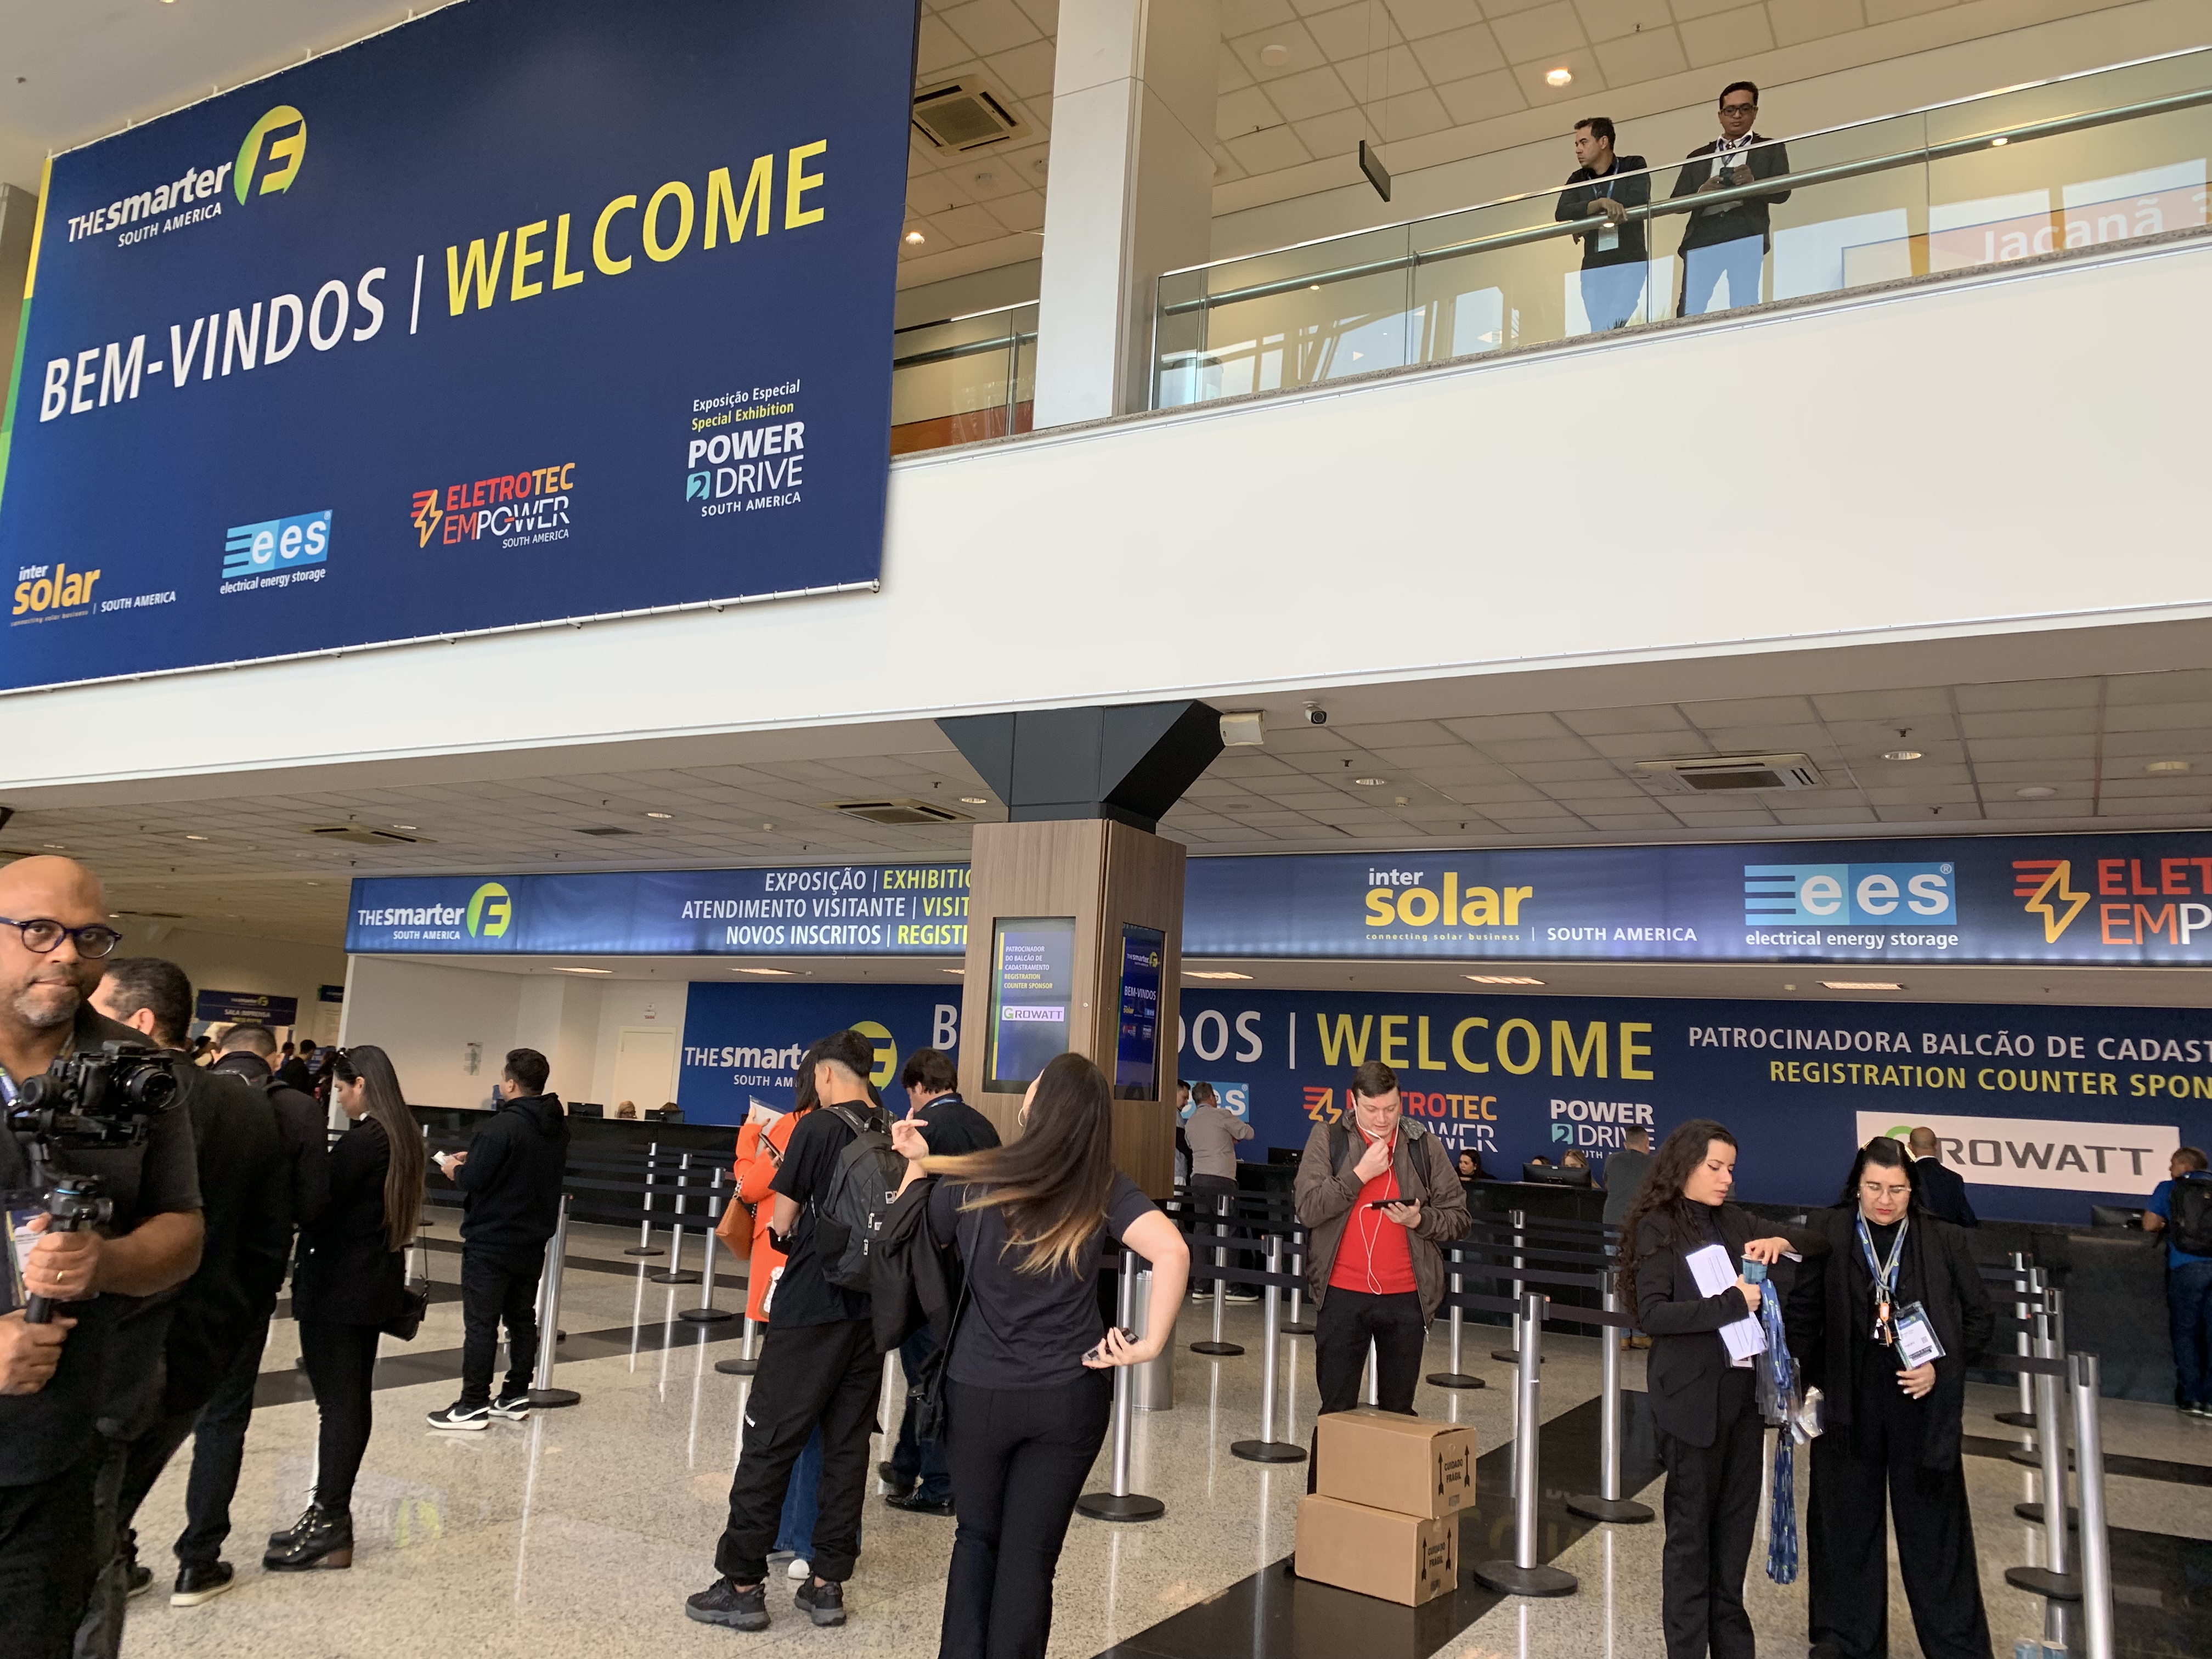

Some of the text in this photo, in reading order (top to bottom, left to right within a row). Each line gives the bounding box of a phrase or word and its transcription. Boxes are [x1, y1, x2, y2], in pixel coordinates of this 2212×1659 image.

[118, 202, 222, 247] SOUTH AMERICA
[40, 139, 827, 422] BEM-VINDOS WELCOME
[693, 379, 800, 413] Exposição Especial
[692, 402, 794, 432] Special Exhibition
[688, 421, 805, 469] POWER
[446, 462, 575, 511] ELETROTEC
[716, 455, 804, 498] DRIVE
[702, 492, 801, 517] SOUTH AMERICA
[443, 495, 570, 544] EMPOWER
[502, 529, 569, 549] SOUTH AMERICA
[19, 565, 49, 582] inter
[220, 568, 326, 595] electrical energy storage
[12, 563, 101, 616] solar
[101, 591, 176, 613] SOUTH AMERICA
[765, 867, 866, 895] EXPOSIÇÃO
[1369, 868, 1423, 885] inter
[682, 899, 806, 919] ATENDIMENTO
[812, 897, 905, 918] VISITANTE
[1365, 872, 1533, 927] solar
[393, 930, 460, 940] SOUTH AMERICA
[726, 926, 785, 945] NOVOS
[791, 924, 881, 945] INSCRITOS
[1366, 933, 1427, 942] connecting
[1469, 933, 1520, 941] business
[1547, 928, 1697, 941] SOUTH AMERICA
[1746, 932, 1959, 950] electrical energy storage
[1125, 986, 1156, 1001] BEM-VINDOS
[1004, 1007, 1063, 1019] GROWATT
[1317, 1013, 1655, 1080] WELCOME
[1689, 1026, 1912, 1054] PATROCINADORA
[1922, 1030, 2035, 1057] BALCÃO
[2047, 1036, 2085, 1059] DE
[733, 1075, 770, 1086] SOUTH
[1771, 1061, 1966, 1089] REGISTRATION
[1978, 1069, 2118, 1096] COUNTER
[1550, 1099, 1654, 1125] POWER
[1885, 1126, 2154, 1176] ROWATT
